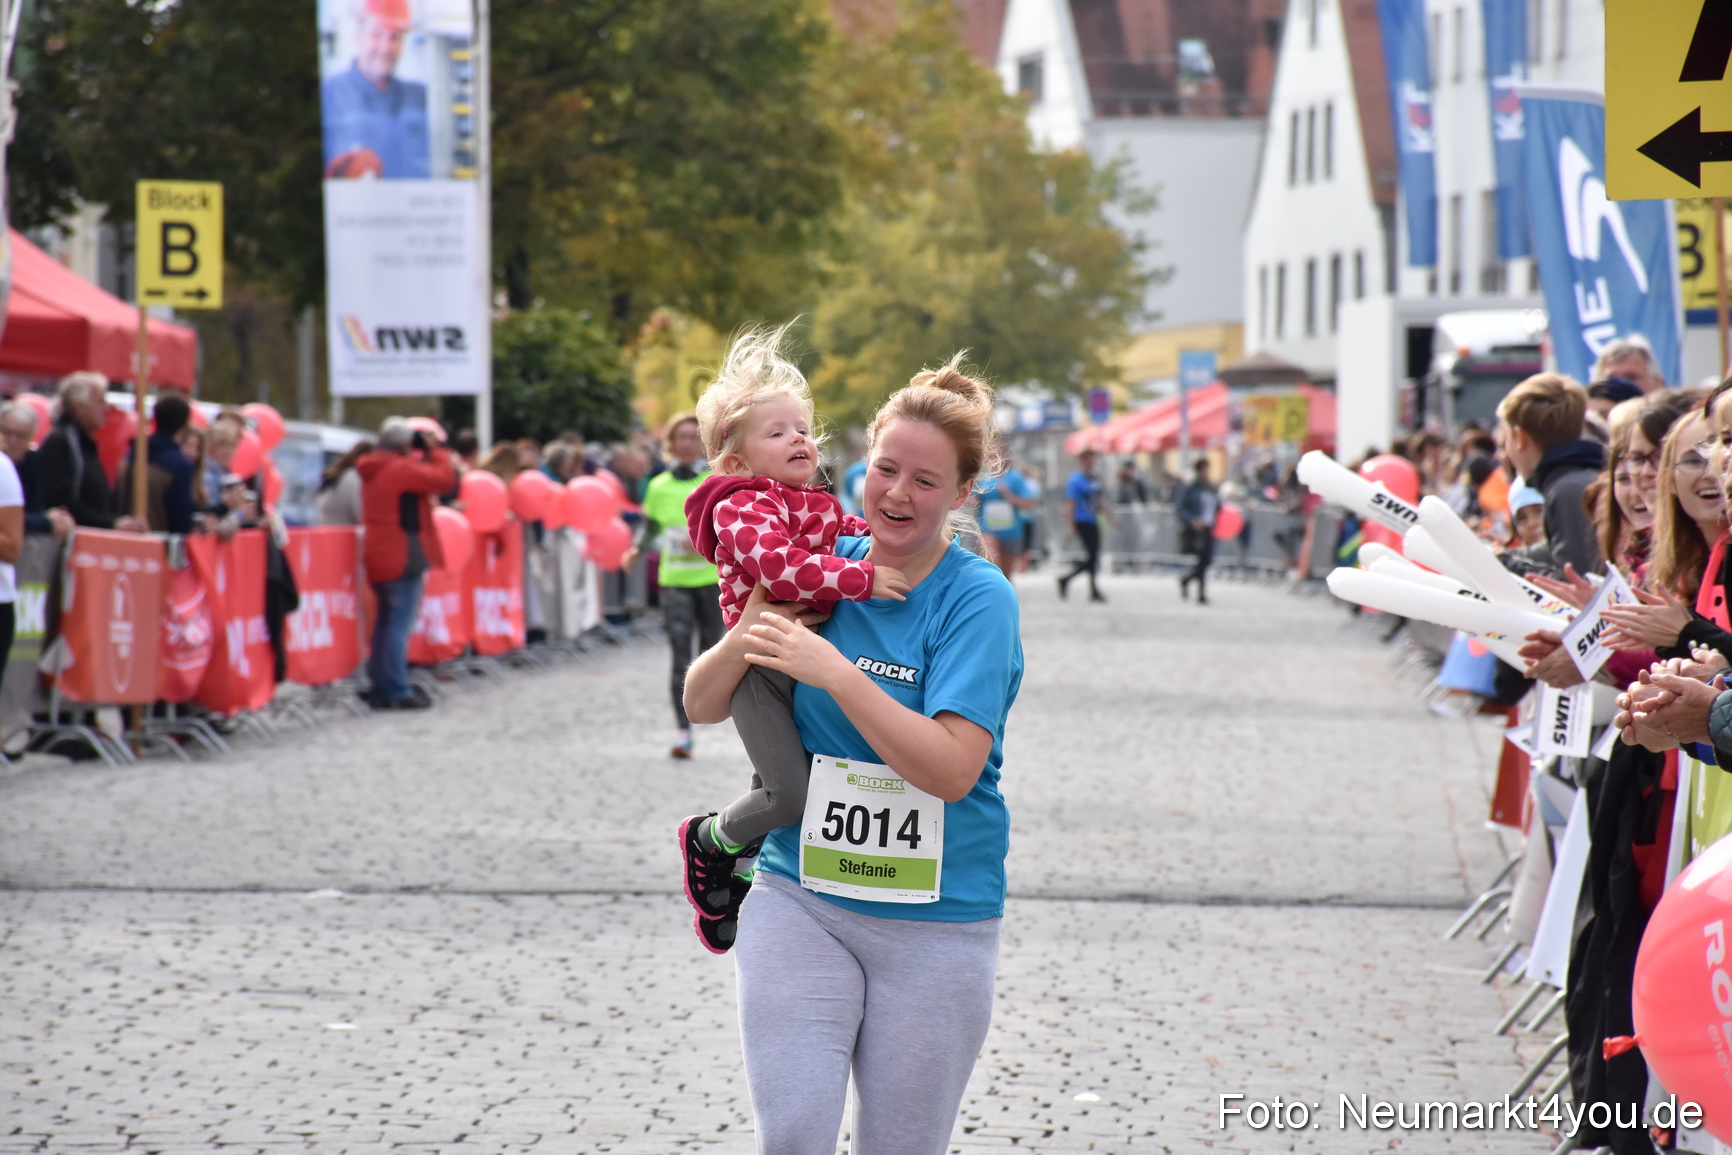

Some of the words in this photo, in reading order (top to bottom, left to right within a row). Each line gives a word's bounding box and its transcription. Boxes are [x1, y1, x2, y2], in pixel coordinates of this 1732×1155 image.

[147, 187, 211, 210] Block
[161, 220, 198, 276] B
[1371, 493, 1418, 522] swn
[855, 656, 919, 684] BOCK
[1553, 695, 1571, 746] swn
[858, 775, 905, 791] BOCK
[821, 801, 921, 849] 5014
[839, 858, 897, 878] Stefanie
